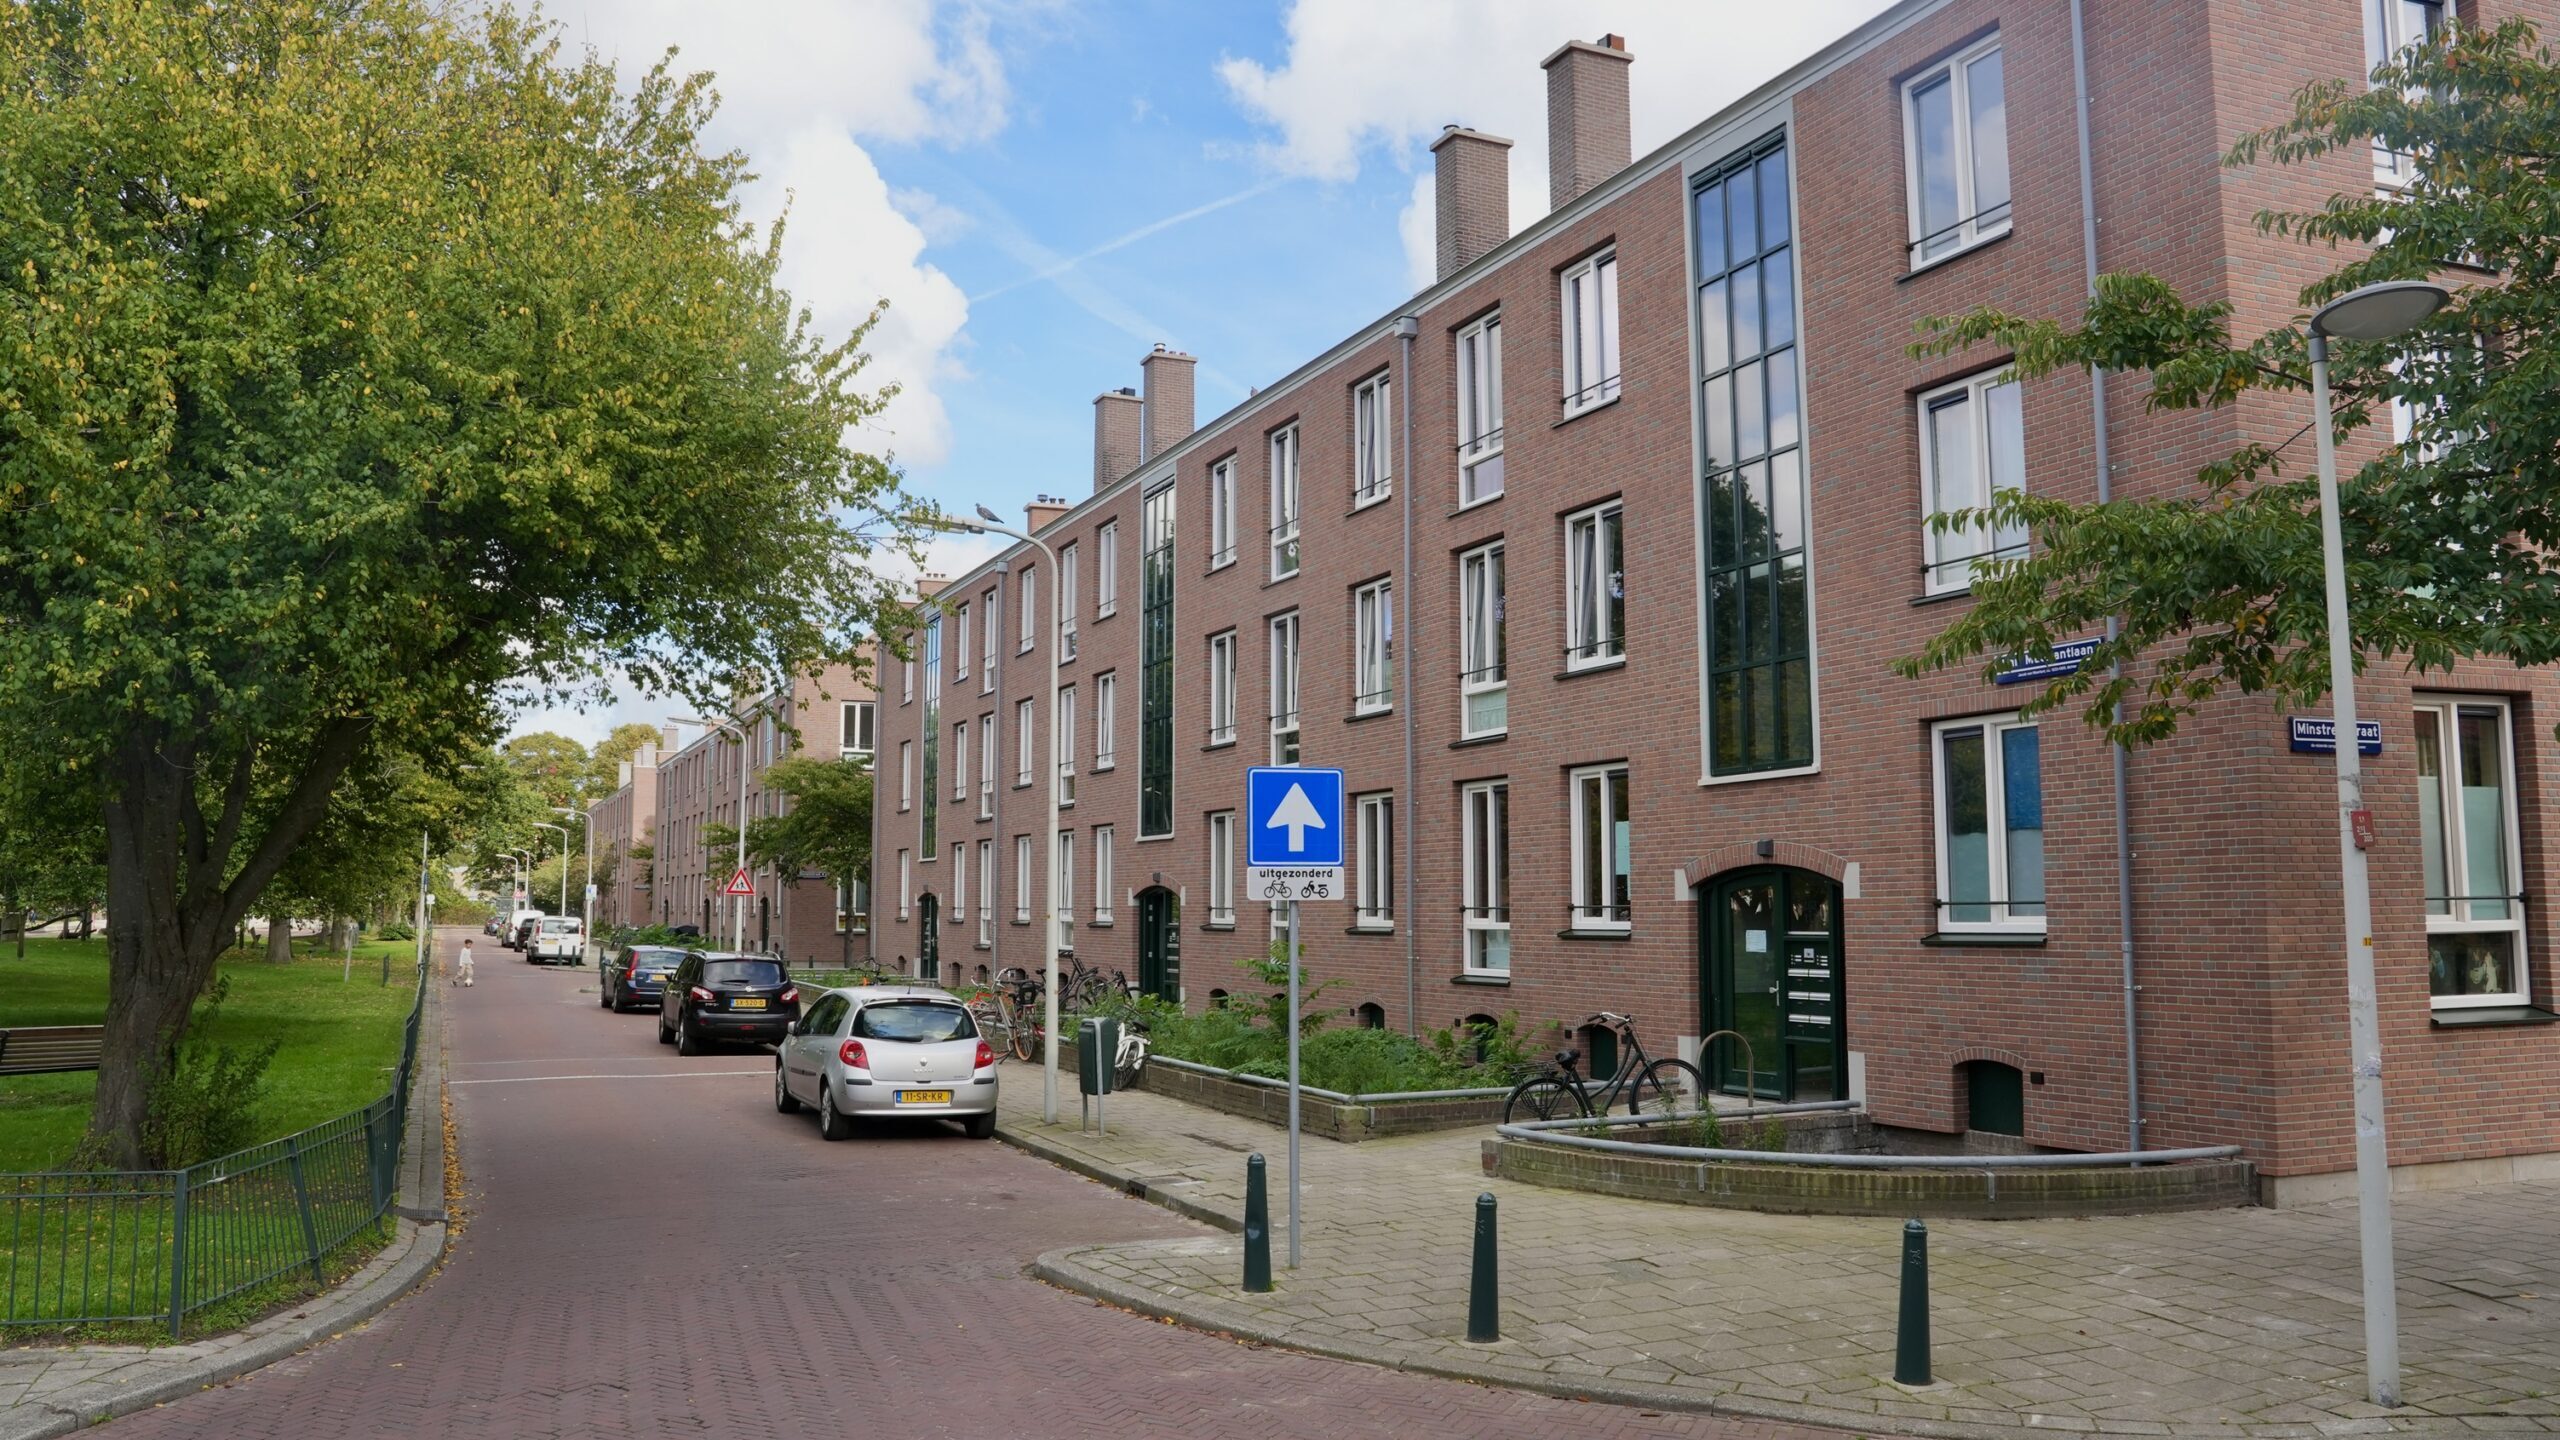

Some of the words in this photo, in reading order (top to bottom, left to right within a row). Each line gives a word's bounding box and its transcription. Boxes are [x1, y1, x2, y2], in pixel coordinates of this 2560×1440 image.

[2025, 645, 2094, 665] Mantlaan
[2297, 722, 2378, 737] Minstreraat
[1259, 869, 1333, 880] uitgezonderd
